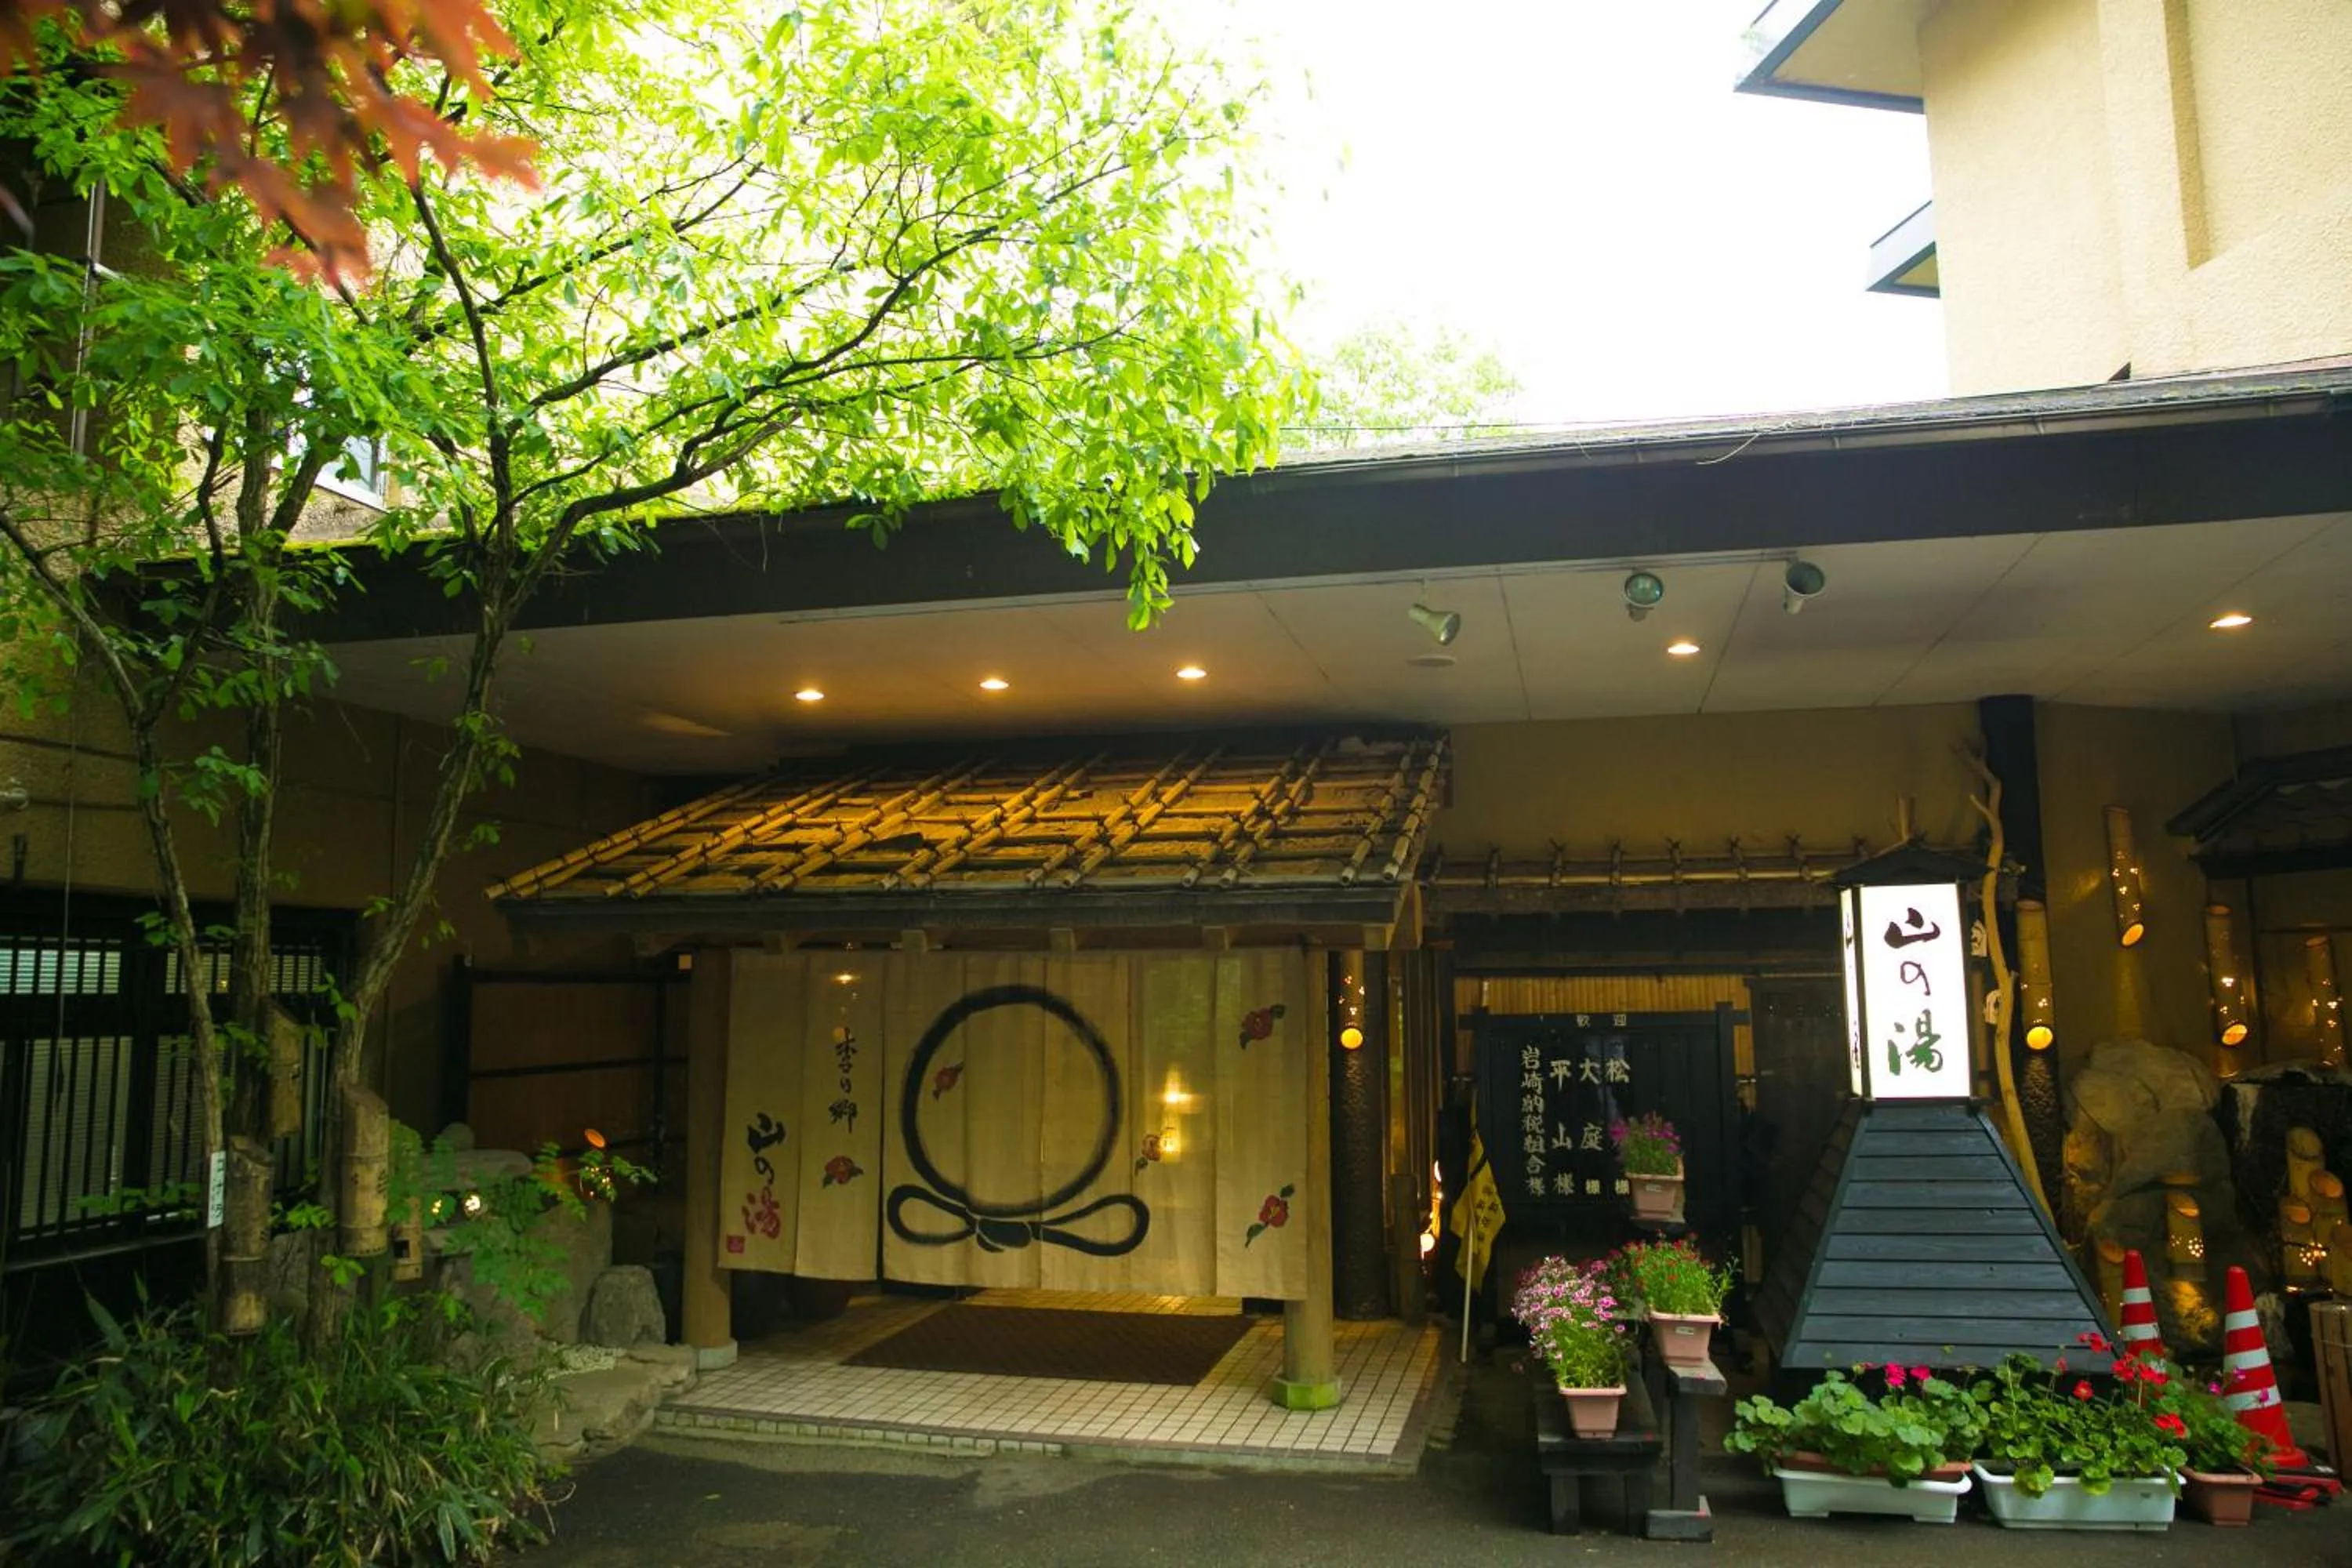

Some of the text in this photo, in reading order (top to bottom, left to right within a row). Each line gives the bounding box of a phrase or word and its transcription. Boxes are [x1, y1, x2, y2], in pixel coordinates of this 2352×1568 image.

[1884, 907, 1943, 1076] 山の湯
[742, 1112, 786, 1240] 山の湯
[1521, 1045, 1545, 1196] 岩崎納税組合様
[1549, 1059, 1575, 1195] 平山様
